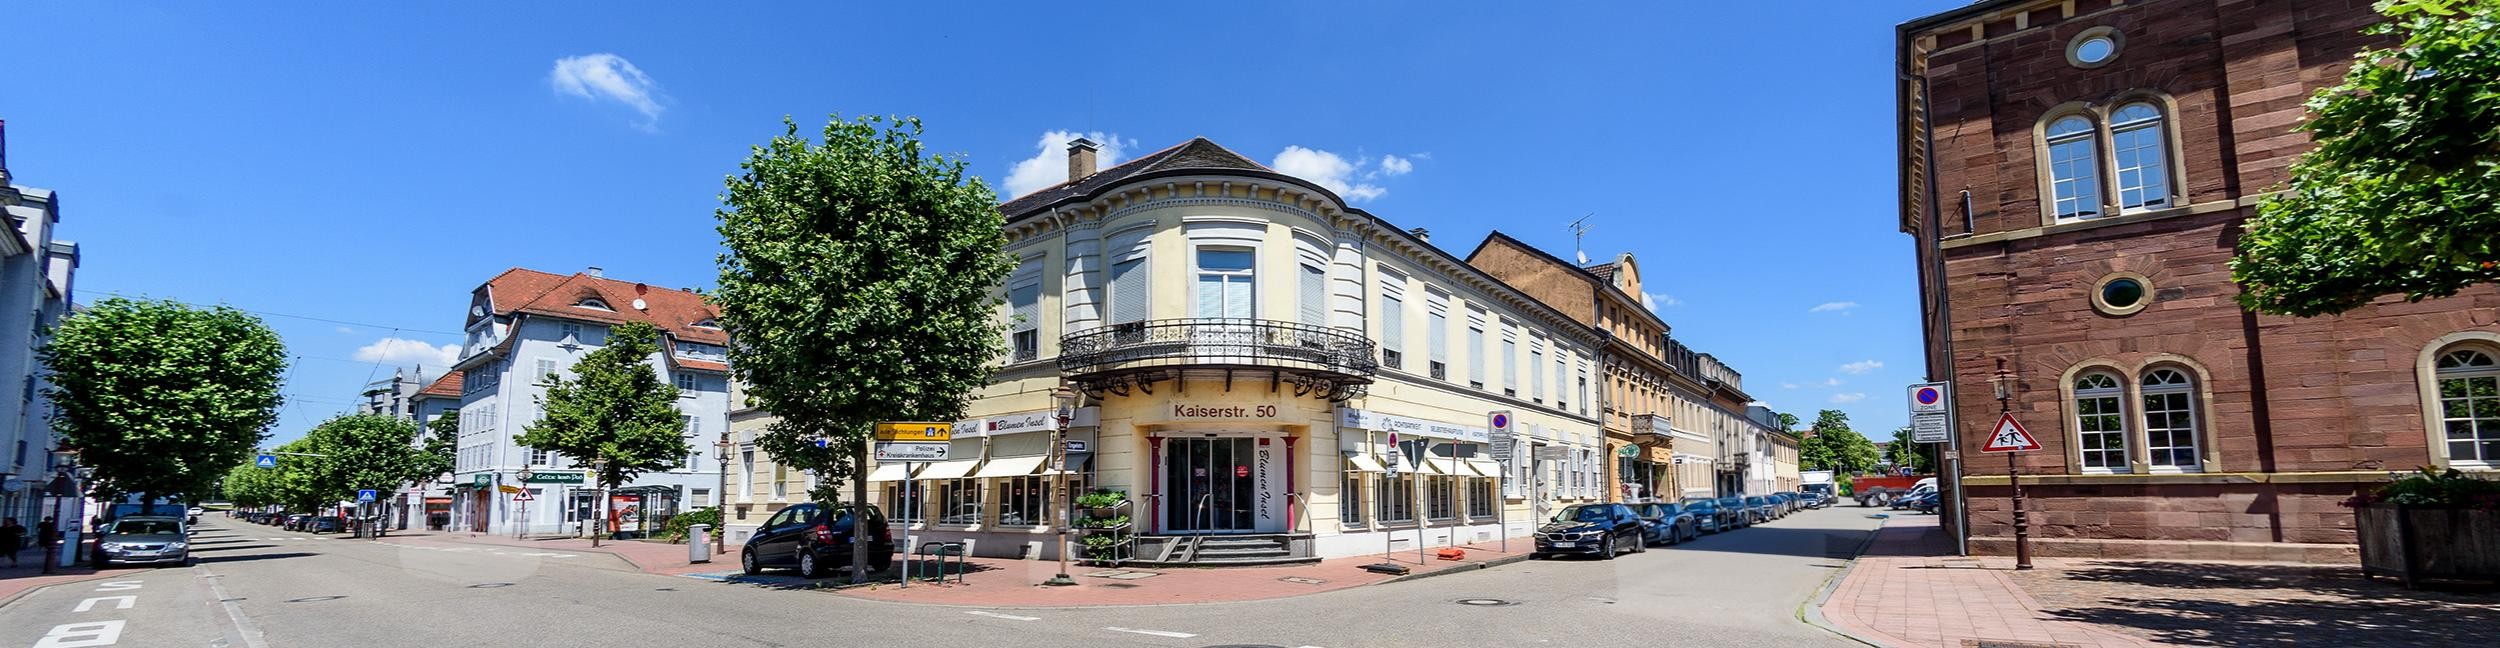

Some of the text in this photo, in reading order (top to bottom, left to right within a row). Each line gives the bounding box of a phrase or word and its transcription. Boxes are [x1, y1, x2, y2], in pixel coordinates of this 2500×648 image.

[1174, 404, 1277, 418] Kaiserstr. 50
[998, 416, 1046, 431] Blumen Insel
[1259, 449, 1271, 520] Blumen Insel
